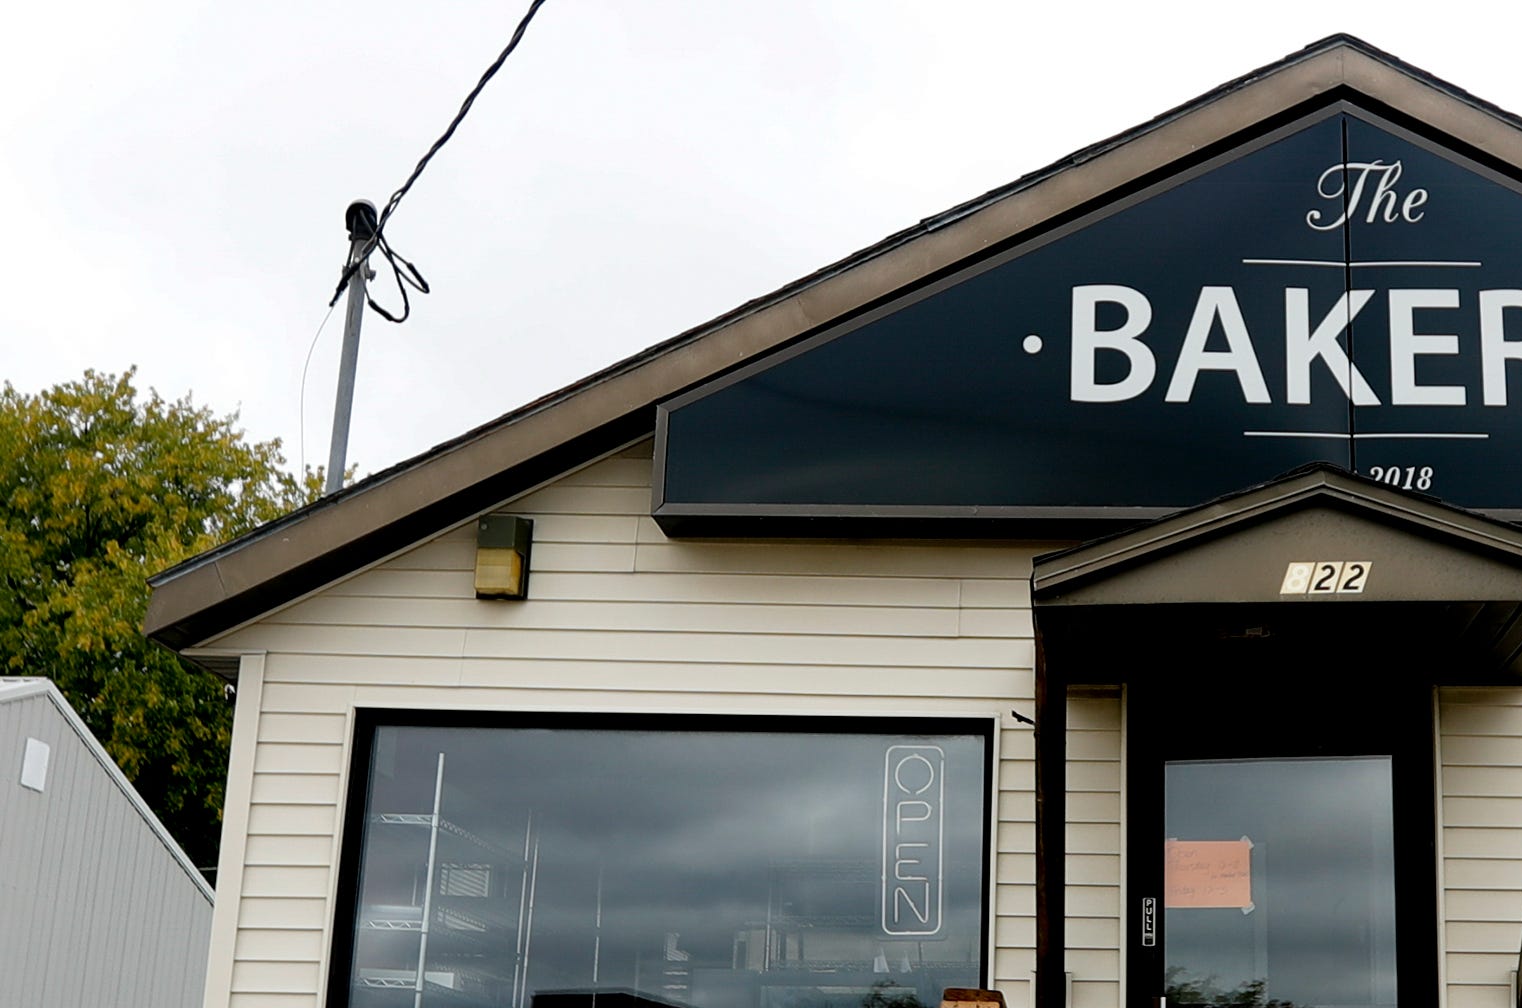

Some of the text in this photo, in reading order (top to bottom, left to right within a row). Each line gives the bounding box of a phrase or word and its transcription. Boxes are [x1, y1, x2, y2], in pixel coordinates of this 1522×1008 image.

[1306, 159, 1428, 231] The
[1369, 466, 1434, 491] 2018
[894, 753, 935, 924] OPEN
[1145, 899, 1153, 931] PULL
